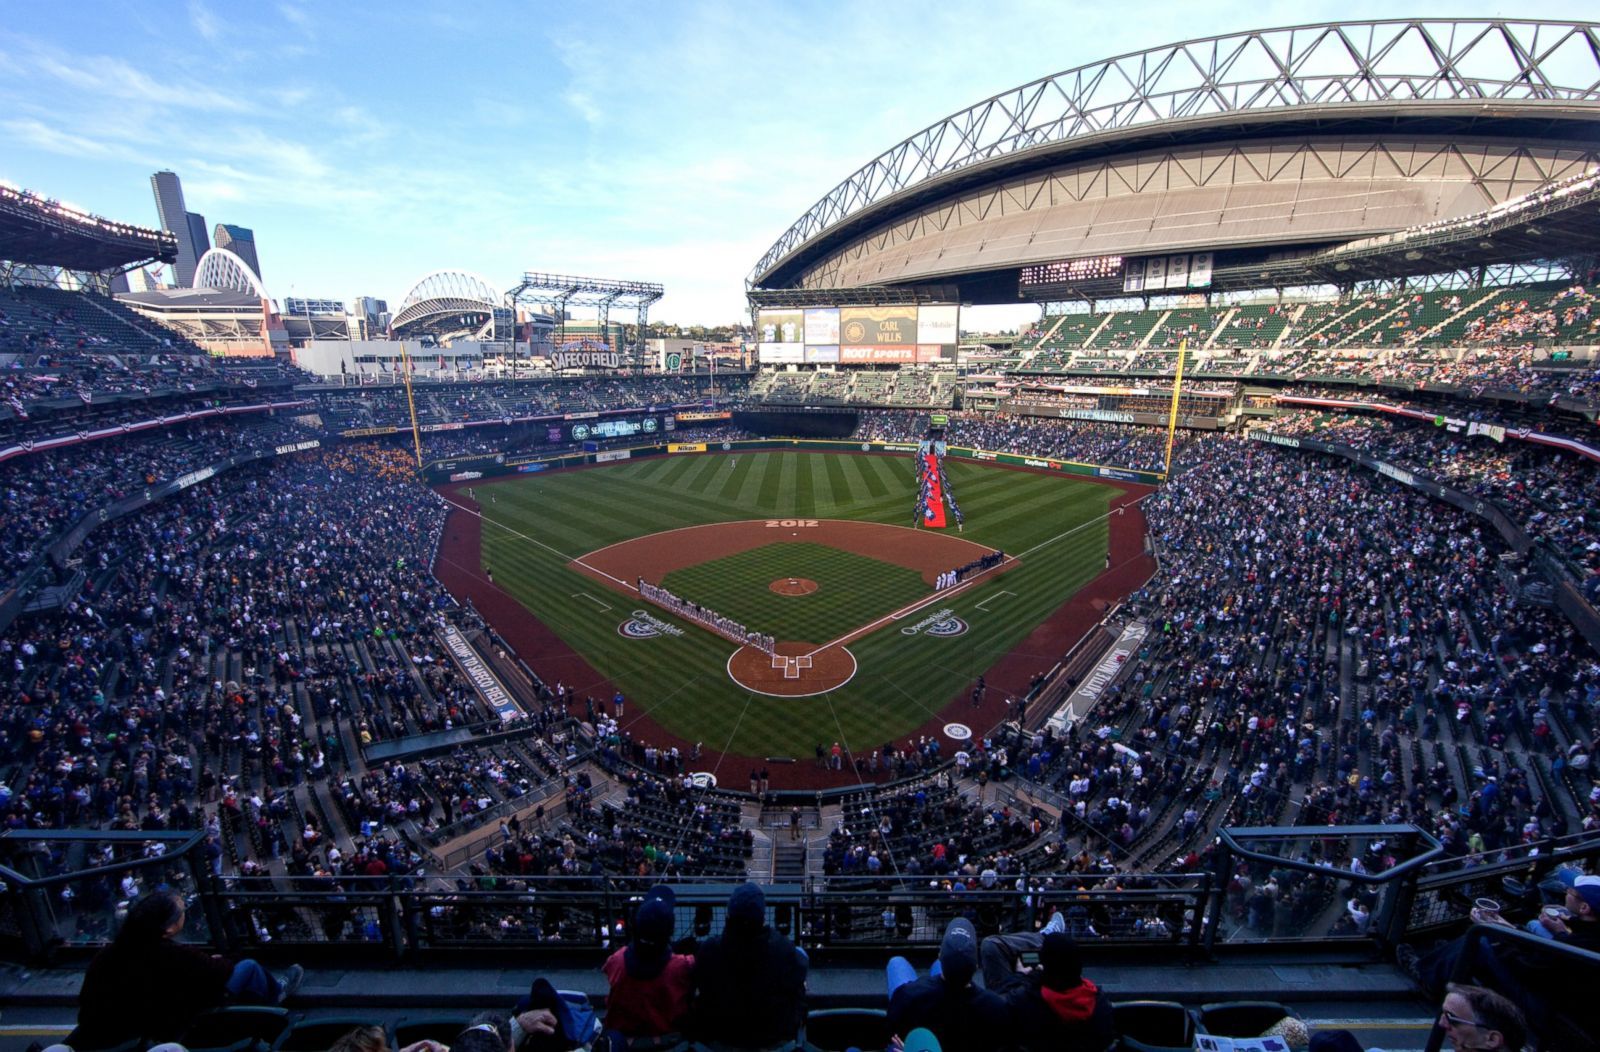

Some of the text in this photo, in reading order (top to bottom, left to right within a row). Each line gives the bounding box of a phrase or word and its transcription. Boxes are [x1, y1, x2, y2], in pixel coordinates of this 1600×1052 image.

[880, 321, 899, 331] CARL
[876, 332, 902, 342] WILLIS
[843, 348, 873, 358] ROOT
[874, 349, 912, 358] SPORTS
[551, 352, 619, 370] SAFECO FIELD
[1059, 409, 1134, 423] SEATTLE MARINERS
[591, 424, 614, 435] SEATTLE
[614, 422, 641, 433] MARINERS
[1249, 432, 1300, 448] SEATTLE MARINERS
[275, 440, 320, 455] SEATTLE MARINERS
[1025, 459, 1048, 467] KeyBank
[445, 632, 509, 707] WELCOME TO SAFECO FIELD
[1078, 671, 1112, 699] SEATTLE
